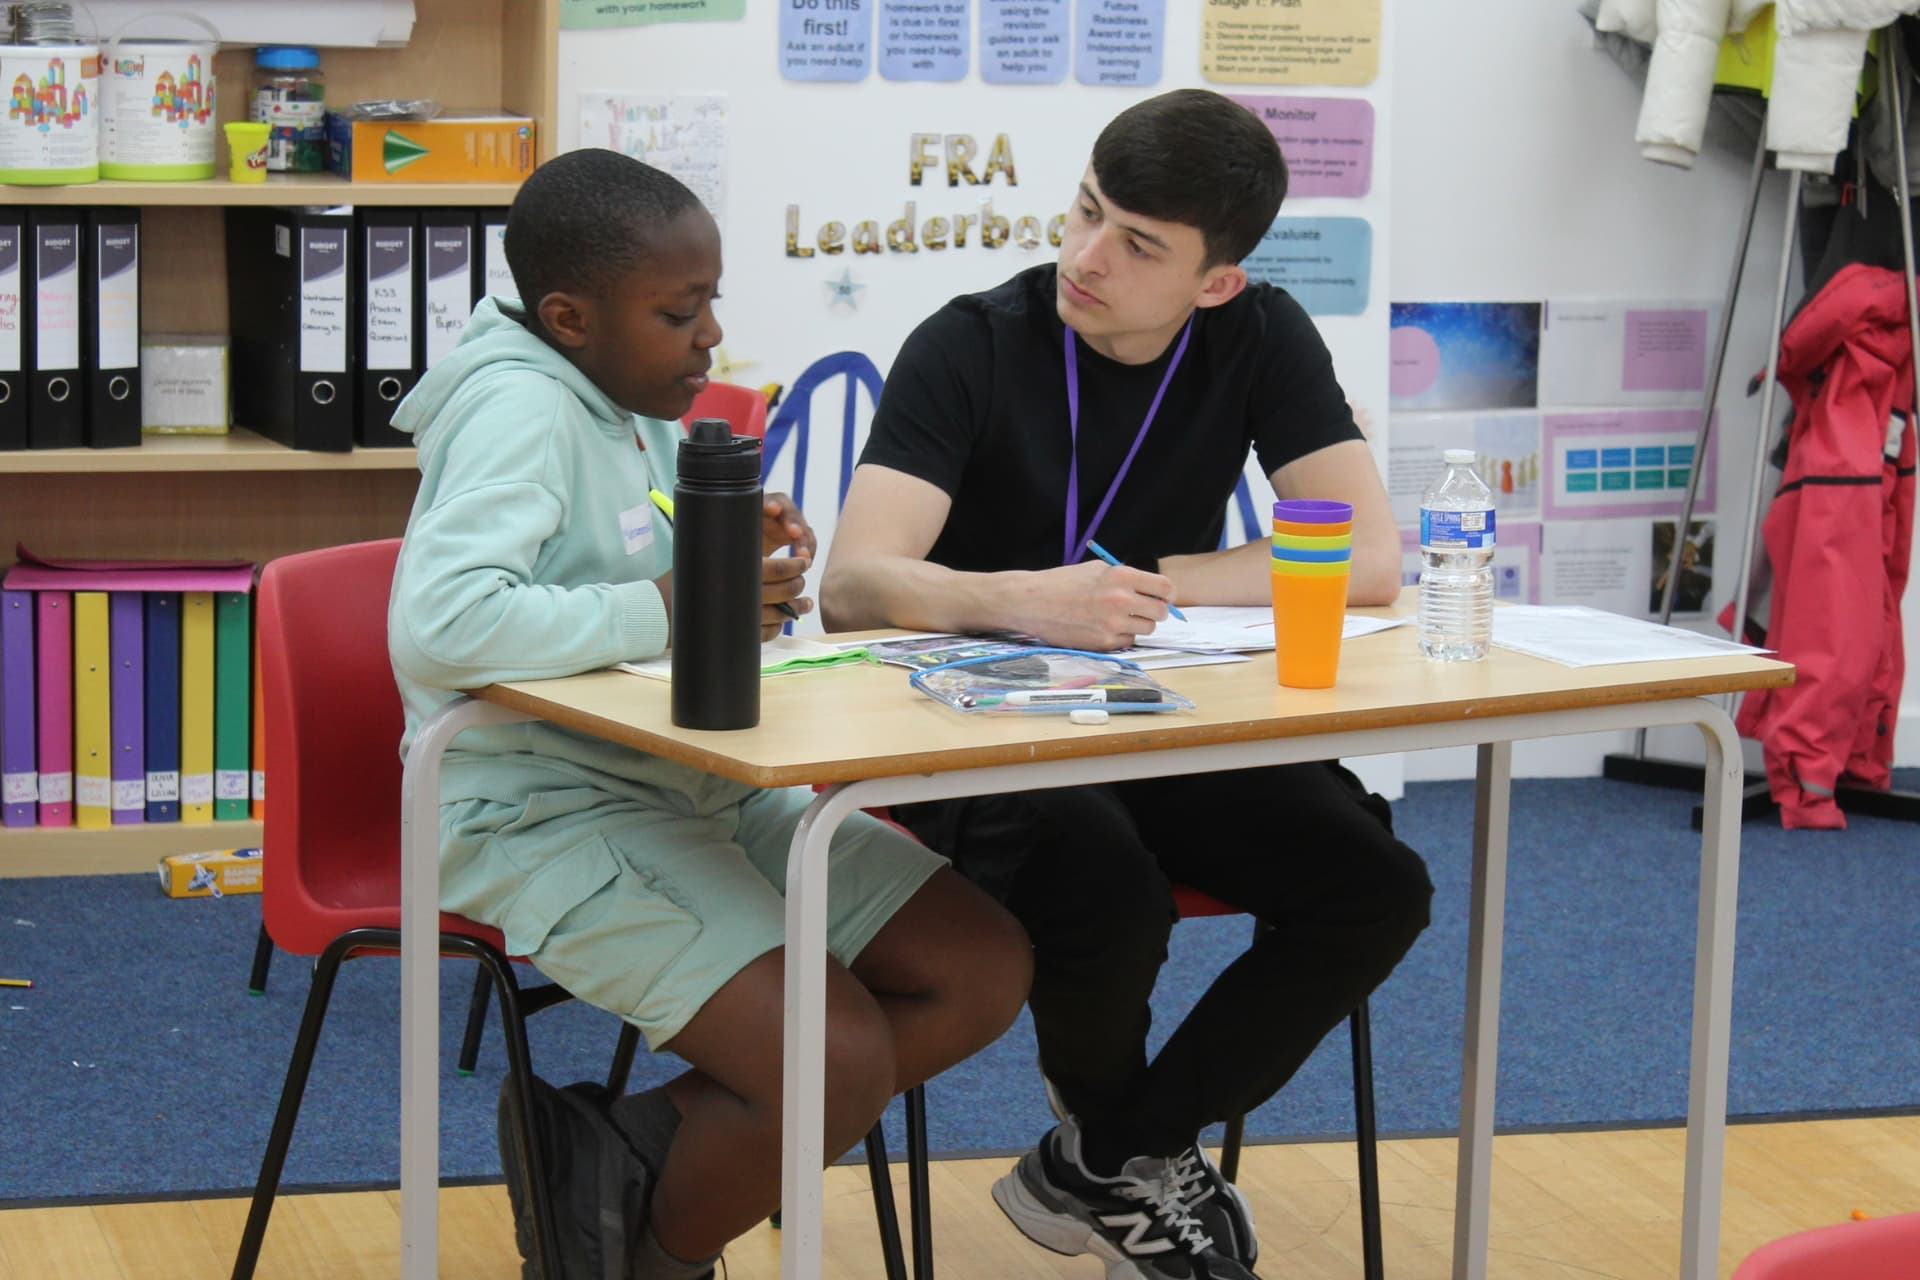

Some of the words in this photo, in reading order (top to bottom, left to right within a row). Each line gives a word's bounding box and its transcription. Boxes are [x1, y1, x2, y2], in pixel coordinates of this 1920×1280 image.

[596, 4, 619, 15] with
[621, 4, 647, 15] your
[649, 1, 708, 12] homework
[791, 0, 818, 11] Do
[826, 0, 861, 11] this
[884, 3, 942, 14] homework
[943, 3, 966, 14] that
[1103, 1, 1140, 12] Future
[999, 7, 1030, 18] using
[1032, 7, 1051, 16] the
[1092, 14, 1149, 26] Readiness
[802, 18, 849, 37] first!
[1002, 21, 1047, 31] revision
[902, 31, 960, 42] homework
[786, 41, 807, 52] Ask
[810, 42, 826, 52] an
[827, 42, 855, 52] adult
[857, 42, 866, 51] if
[786, 57, 807, 69] you
[809, 56, 838, 67] need
[839, 56, 864, 69] help
[1264, 106, 1318, 121] Monitor
[909, 132, 1018, 187] FRA
[785, 197, 1068, 258] Leaderboa
[374, 287, 398, 298] KS3
[1099, 1211, 1176, 1255] N
